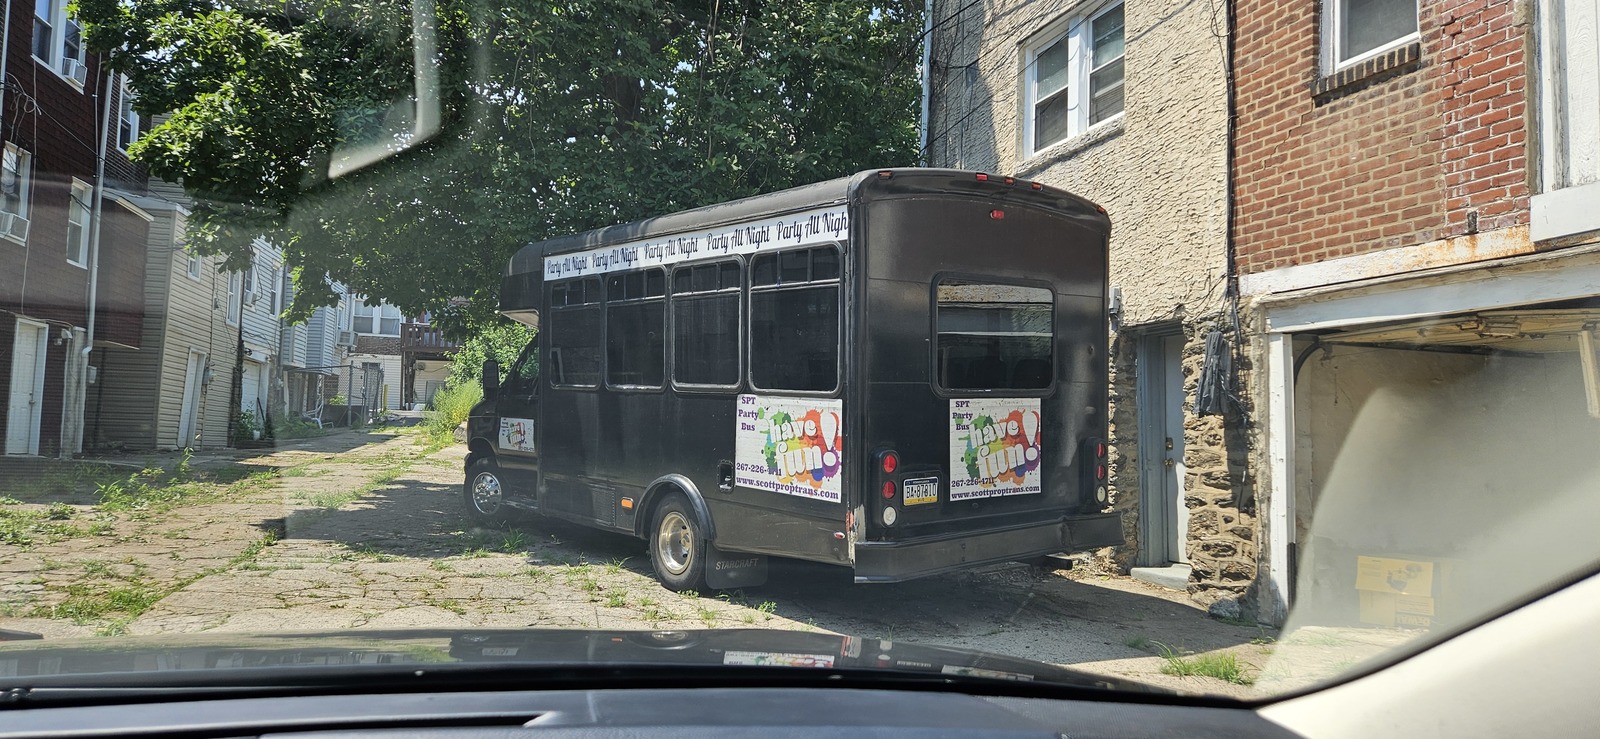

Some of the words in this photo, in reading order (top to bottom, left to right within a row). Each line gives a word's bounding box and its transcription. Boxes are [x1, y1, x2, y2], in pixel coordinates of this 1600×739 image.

[547, 260, 561, 277] Party
[562, 257, 571, 274] All
[572, 256, 587, 275] Night
[592, 252, 608, 270] Party
[609, 249, 619, 267] All
[620, 247, 638, 267] Night
[644, 242, 663, 262] Party
[665, 239, 676, 259] All
[677, 236, 698, 259] Night
[706, 233, 729, 253] Party
[731, 229, 743, 250] All
[745, 225, 770, 249] Night
[776, 221, 802, 243] Party
[805, 215, 820, 238] All
[822, 211, 848, 238] Nigh
[741, 396, 756, 405] SPT
[955, 400, 970, 408] SPT
[738, 409, 759, 421] Party
[952, 412, 973, 420] Party
[741, 422, 755, 431] Bus
[769, 419, 818, 443] have
[956, 423, 970, 431] Bus
[969, 420, 1020, 449] have
[736, 476, 839, 500] www.scottproptrans.com
[951, 485, 1040, 499] www.scottproptrans.com
[715, 558, 759, 570] STARCRAFT
